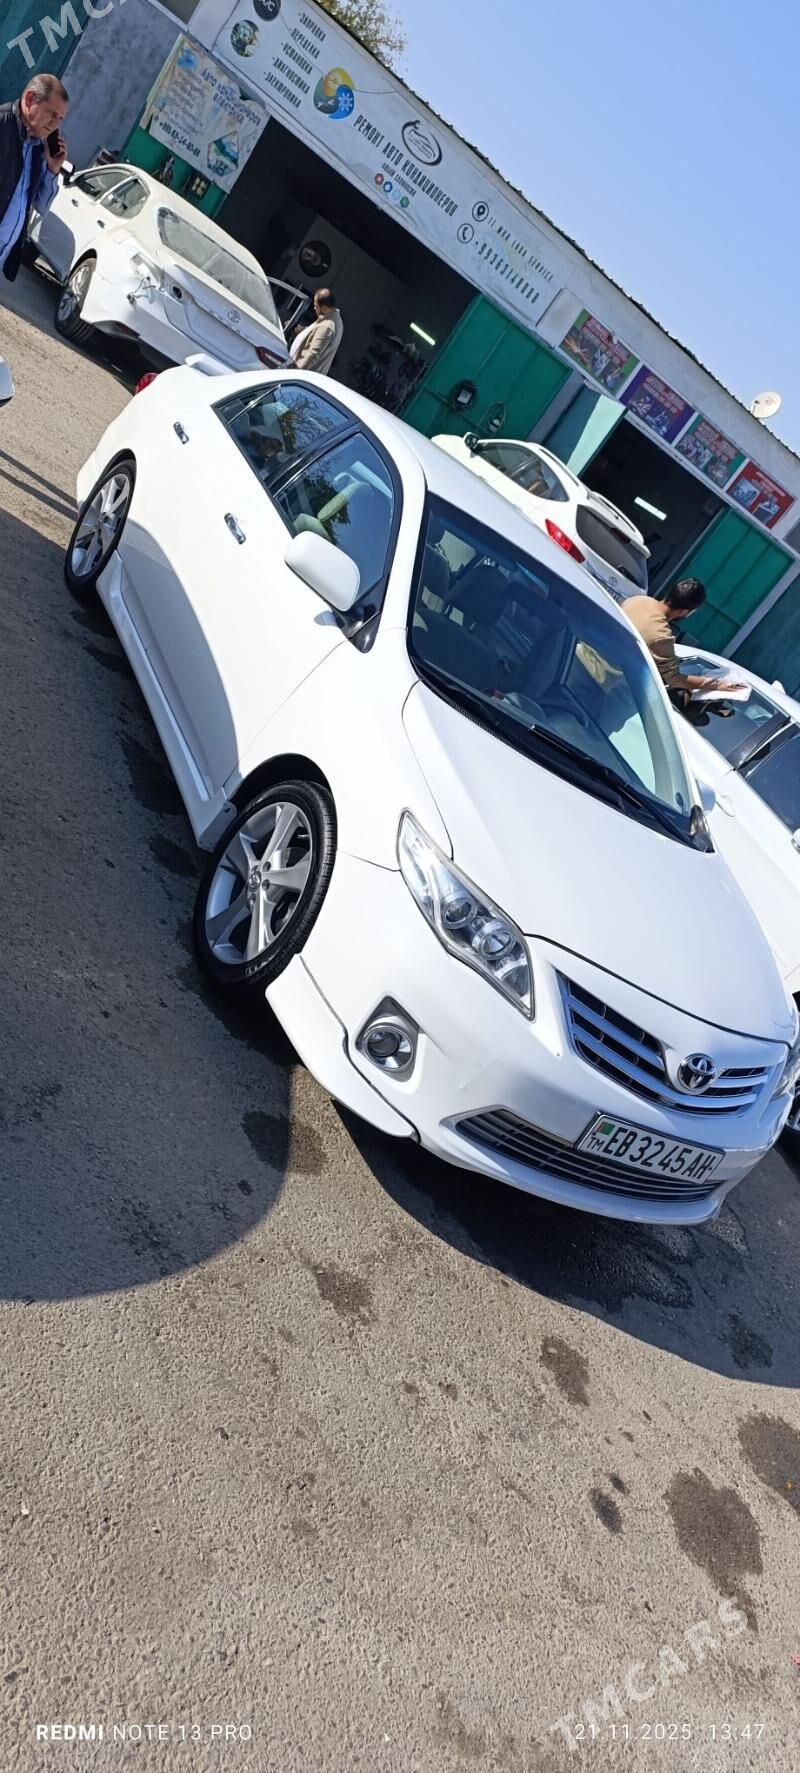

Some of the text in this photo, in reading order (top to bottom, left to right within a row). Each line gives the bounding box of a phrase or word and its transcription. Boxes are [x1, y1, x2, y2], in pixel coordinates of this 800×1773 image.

[354, 115, 384, 148] РЕМОНТ
[382, 142, 404, 166] АВТО
[401, 160, 458, 217] КОНДИЦИОНЕРОВ
[528, 256, 554, 283] SERVICE
[587, 1136, 604, 1151] TM
